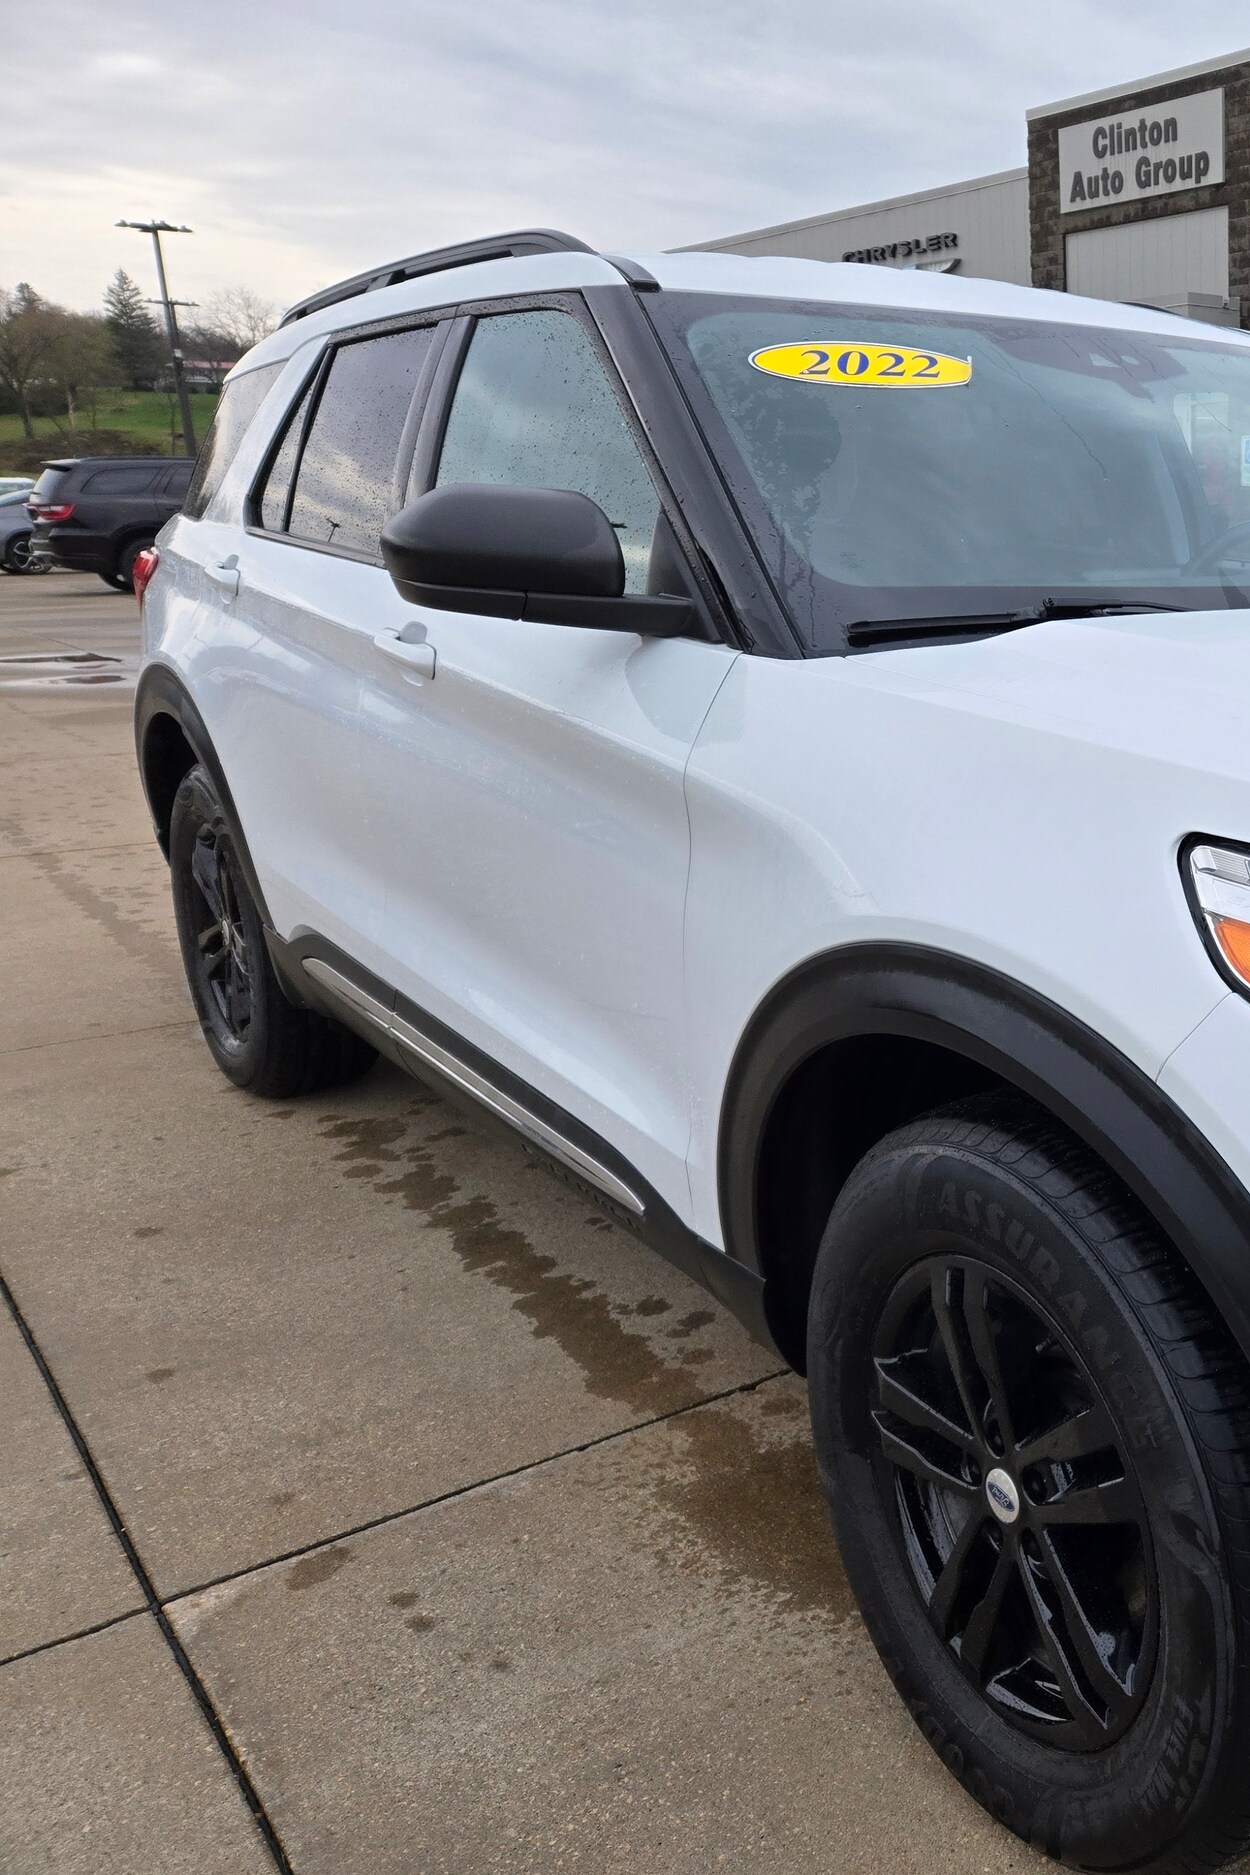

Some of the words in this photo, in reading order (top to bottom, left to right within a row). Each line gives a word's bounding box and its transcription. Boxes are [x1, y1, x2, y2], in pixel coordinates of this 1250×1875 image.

[1092, 116, 1178, 158] Clinton
[1069, 167, 1124, 203] Auto
[1135, 150, 1210, 189] Group
[841, 232, 959, 264] CHRYSLER
[798, 349, 941, 378] 2022
